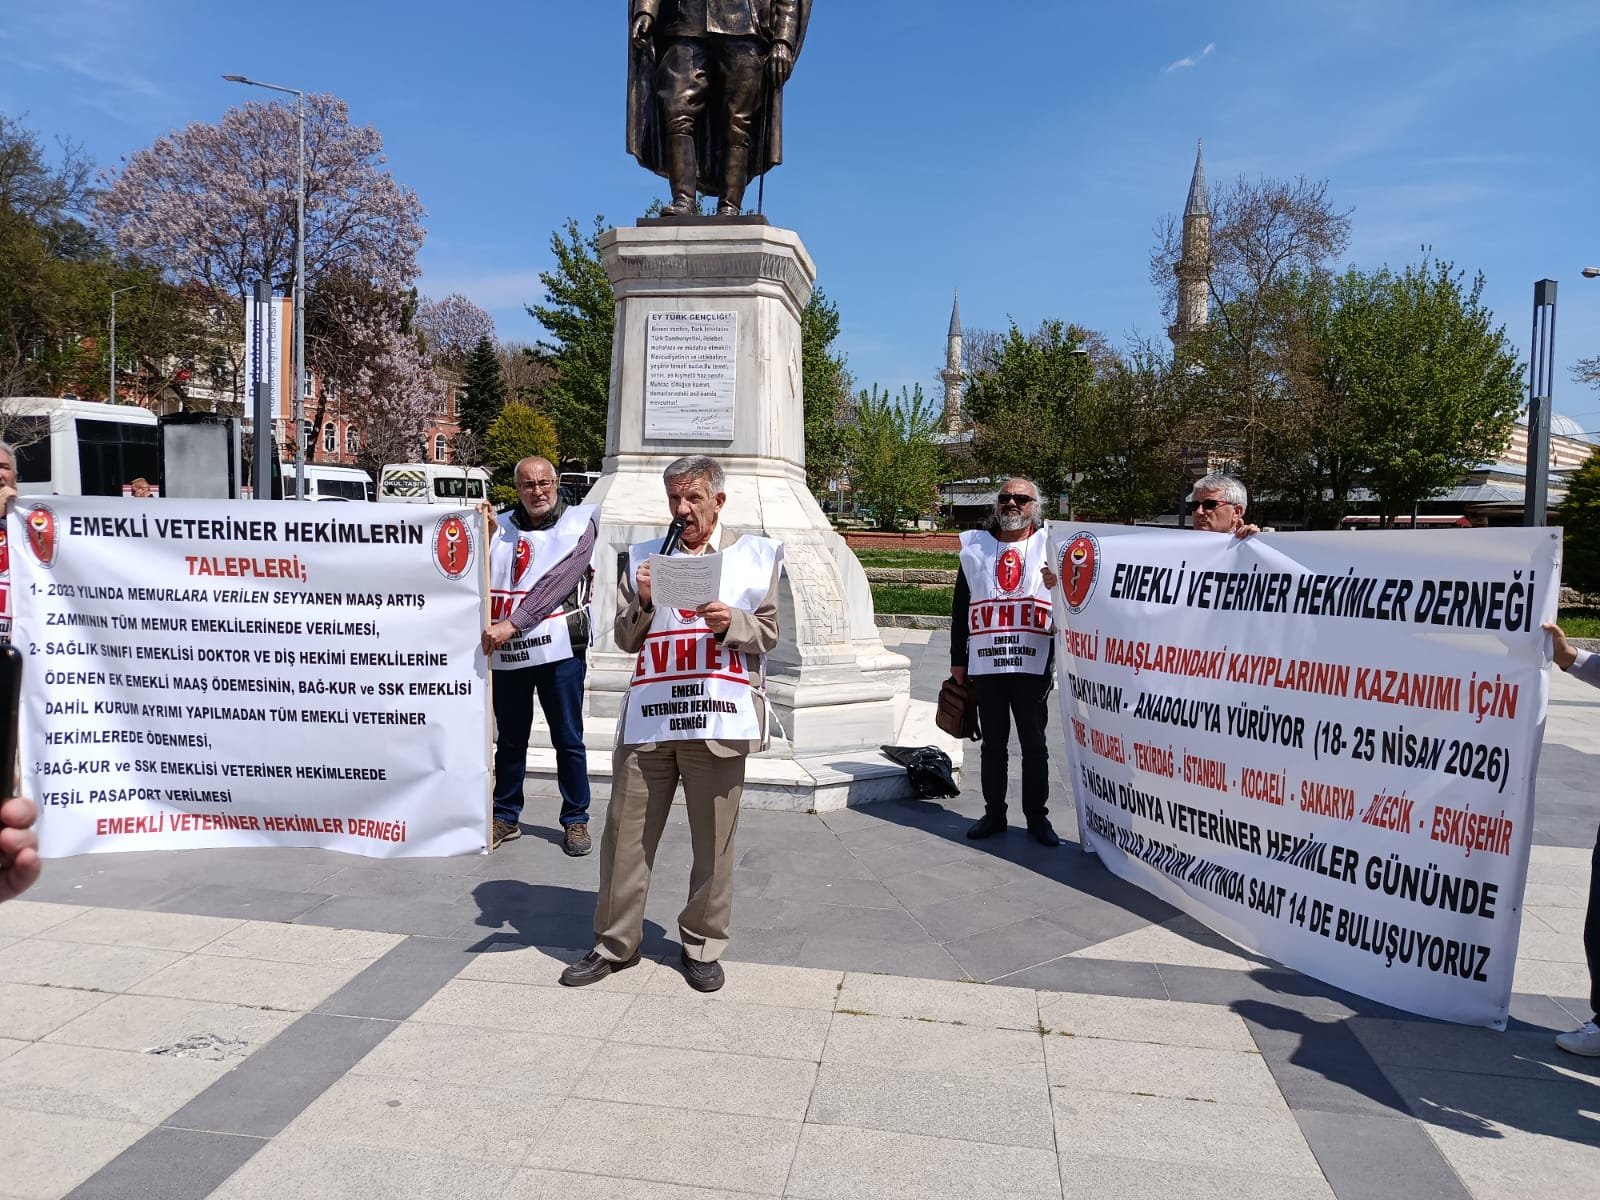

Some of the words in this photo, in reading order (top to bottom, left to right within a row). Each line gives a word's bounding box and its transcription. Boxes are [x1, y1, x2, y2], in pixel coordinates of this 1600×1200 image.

[69, 513, 148, 539] EMEKLİ
[155, 515, 277, 543] VETERİNER
[284, 517, 424, 545] HEKİMLERİN
[185, 555, 308, 583] TALEPLERİ;
[30, 583, 43, 596] 1-
[48, 584, 75, 598] 2023
[76, 586, 124, 601] YILINDA
[128, 587, 208, 602] MEMURLARA
[213, 588, 269, 604] VERİLEN
[273, 591, 344, 606] SEYYANEN
[346, 592, 382, 609] MAAŞ
[386, 593, 426, 609] ARTIŞ
[1110, 560, 1186, 604] EMEKLİ
[1187, 563, 1290, 613] VETERİNER
[1293, 567, 1414, 622] HEKİMLER
[1415, 569, 1535, 632] DERNEĞİ
[46, 613, 108, 629] ZAMMININ
[112, 614, 138, 631] TÜM
[141, 617, 188, 632] MEMUR
[191, 617, 303, 635] EMEKLİLERİNEDE
[306, 620, 380, 637] VERİLMESİ,
[971, 604, 1048, 630] EVHED
[513, 634, 552, 652] HEKİMLER
[994, 634, 1020, 645] EMEKLİ
[29, 642, 41, 656] 2-
[45, 640, 99, 656] SAĞLIK
[100, 643, 134, 659] SINIFI
[135, 644, 194, 661] EMEKLİSİ
[198, 648, 250, 663] DOKTOR
[254, 649, 271, 663] VE
[274, 649, 295, 666] DİŞ
[300, 648, 345, 665] HEKİMİ
[349, 651, 448, 667] EMEKLİLERİNE
[500, 650, 530, 663] DERNEĞİ
[993, 656, 1022, 667] DERNEĞİ
[45, 669, 106, 685] ÖDENEN
[109, 672, 124, 686] EK
[125, 673, 169, 689] EMEKLİ
[172, 677, 207, 693] MAAŞ
[211, 676, 295, 695] ÖDEMESİNİN,
[299, 677, 357, 695] BAĞ-KUR
[360, 684, 375, 695] ve
[378, 682, 404, 696] SSK
[408, 680, 472, 696] EMEKLİSİ
[1065, 629, 1099, 661] EMEKLİ
[1105, 637, 1227, 680] MAAŞLARINDAKİ
[1226, 652, 1349, 697] KAYIPLARININ
[1355, 668, 1459, 712] KAZANIMI
[1468, 671, 1519, 724] İÇİN
[671, 683, 704, 698] EMEKLİ
[45, 700, 89, 716] DAHİL
[94, 701, 139, 717] KURUM
[142, 704, 182, 718] AYRIMI
[185, 706, 266, 722] YAPILMADAN
[269, 706, 298, 723] TÜM
[301, 707, 349, 724] EMEKLİ
[353, 709, 426, 726] VETERİNER
[641, 702, 689, 718] VETERİNER
[690, 699, 738, 714] HEKİMLER
[669, 714, 707, 731] DERNEĞİ
[1068, 673, 1122, 713] TRAKYA'DAN
[1133, 692, 1221, 733] ANADOLU'YA
[1227, 702, 1304, 749] YÜRÜYOR
[1314, 719, 1347, 761] (18-
[1352, 730, 1375, 762] 25
[1381, 724, 1445, 771] NİSAN
[1444, 740, 1510, 794] 2026)
[45, 728, 144, 745] HEKİMLEREDE
[146, 731, 212, 749] ÖDENMESİ,
[43, 759, 110, 775] BAĞ-KUR
[115, 762, 131, 772] ve
[135, 759, 157, 773] SSK
[160, 761, 218, 777] EMEKLİSİ
[222, 762, 292, 779] VETERİNER
[295, 765, 386, 781] HEKİMLEREDE
[42, 789, 84, 808] YEŞİL
[89, 788, 161, 803] PASAPORT
[165, 787, 232, 803] VERİLMESİ
[1090, 728, 1125, 765] KIRKLARELİ
[1133, 740, 1174, 779] TEKİRDAĞ
[1183, 747, 1228, 792] İSTANBUL
[1241, 768, 1286, 806] KOCAELİ
[1300, 780, 1355, 821] SAKARYA
[1430, 803, 1513, 857] ESKİŞEHİR
[96, 811, 164, 836] EMEKLİ
[169, 811, 260, 833] VETERİNER
[264, 814, 344, 835] HEKİMLER
[347, 816, 407, 843] DERNEĞİ
[1087, 765, 1117, 806] NİSAN
[1119, 782, 1165, 825] DÜNYA
[1167, 800, 1262, 855] VETERİNER
[1266, 829, 1359, 884] HEKİMLER
[1365, 853, 1499, 920] GÜNÜNDE
[1117, 825, 1145, 858] ULUS
[1143, 838, 1196, 880] ATATÜRK
[1188, 857, 1245, 902] ANITINDA
[1248, 877, 1287, 920] SAAT
[1289, 892, 1305, 928] 14
[1309, 899, 1331, 938] DE
[1335, 909, 1491, 983] BULUŞUYORUZ
